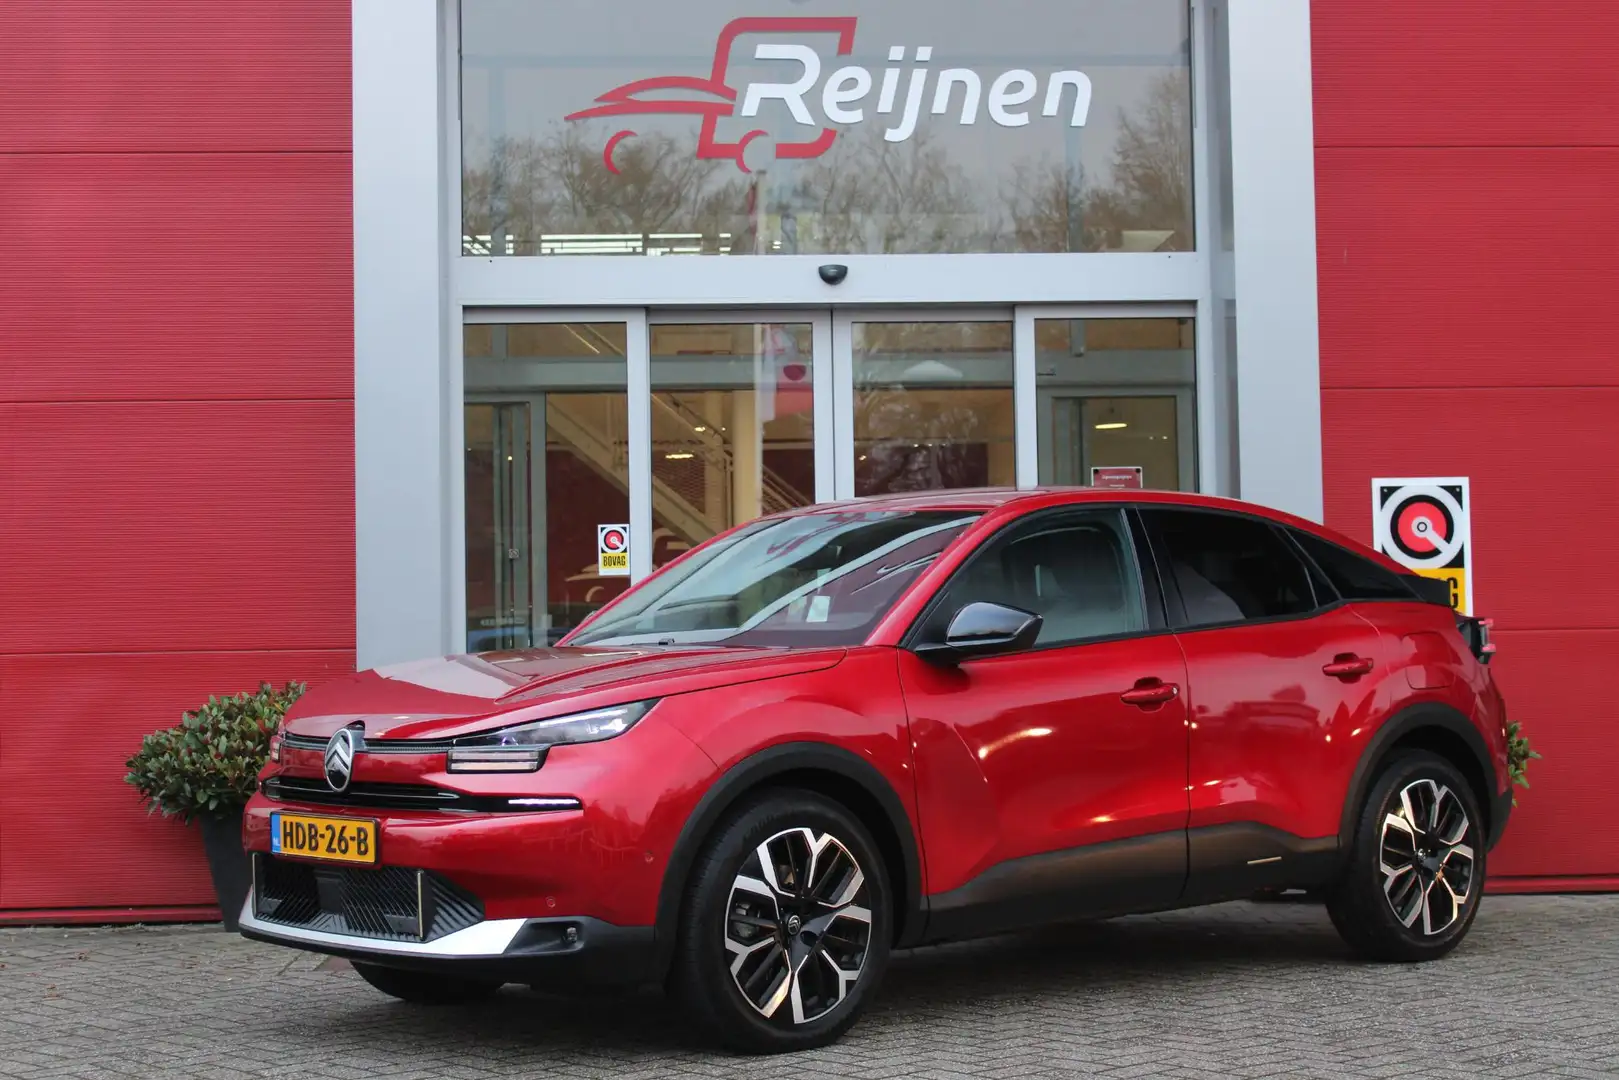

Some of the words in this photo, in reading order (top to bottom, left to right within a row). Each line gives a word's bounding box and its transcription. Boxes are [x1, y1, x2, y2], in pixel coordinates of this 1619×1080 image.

[740, 44, 1092, 143] Reijnen
[603, 556, 626, 567] BOVAG
[282, 820, 369, 856] HDB-26-B
